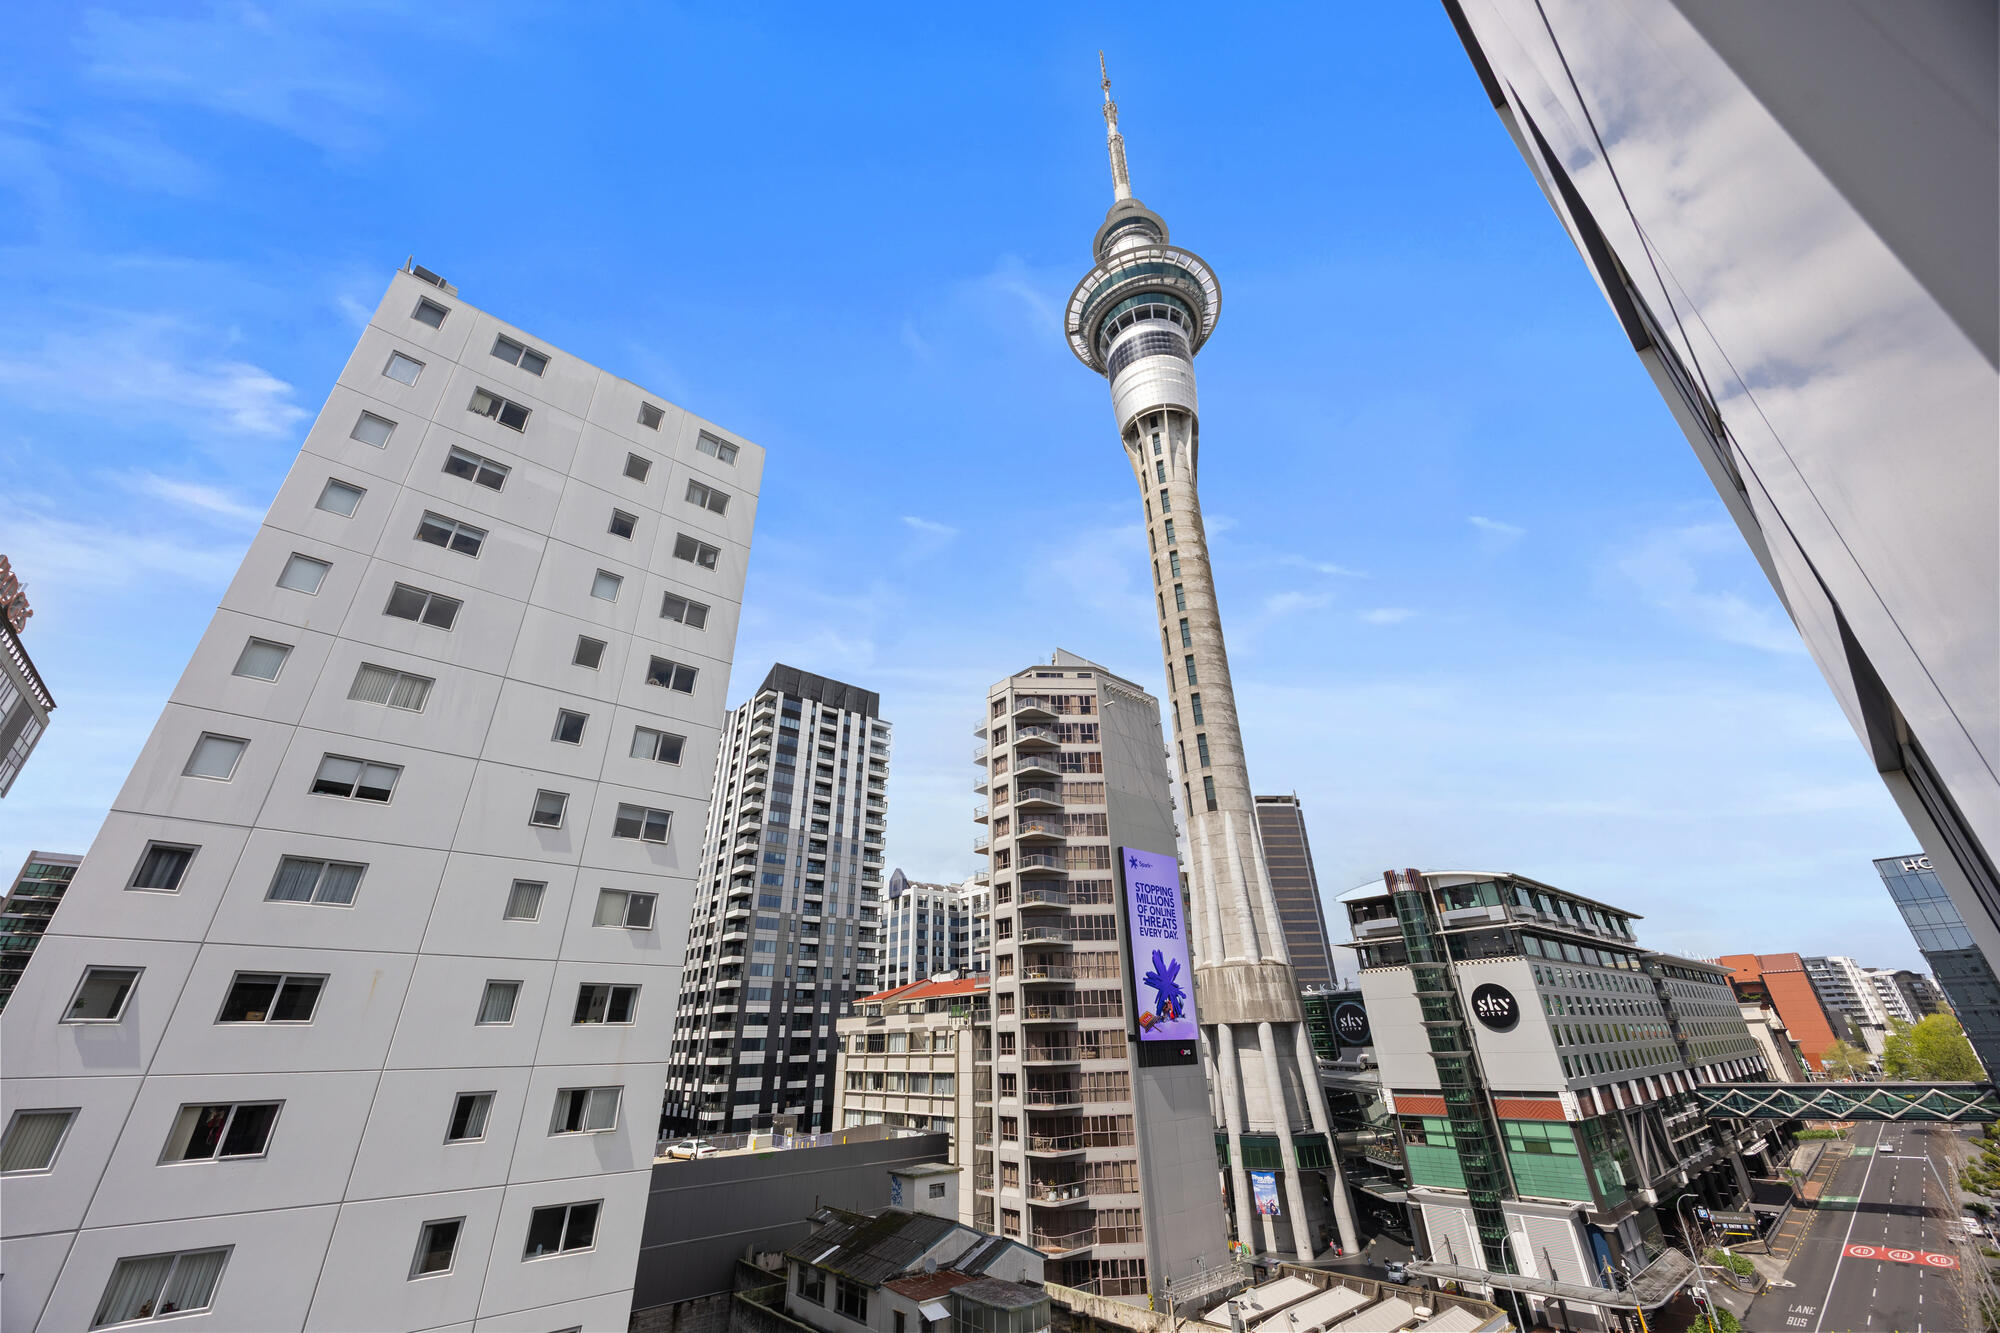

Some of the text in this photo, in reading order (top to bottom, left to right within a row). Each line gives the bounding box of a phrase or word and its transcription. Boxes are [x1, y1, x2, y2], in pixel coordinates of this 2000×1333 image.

[1135, 882, 1173, 897] STOPPING
[1136, 893, 1175, 908] MILLIONS
[1137, 904, 1176, 918] OF ONLINE
[1138, 914, 1177, 930] THREATS
[1139, 927, 1179, 940] EVERY DAY.
[1788, 1304, 1816, 1315] LANE
[1786, 1316, 1808, 1327] BUS
